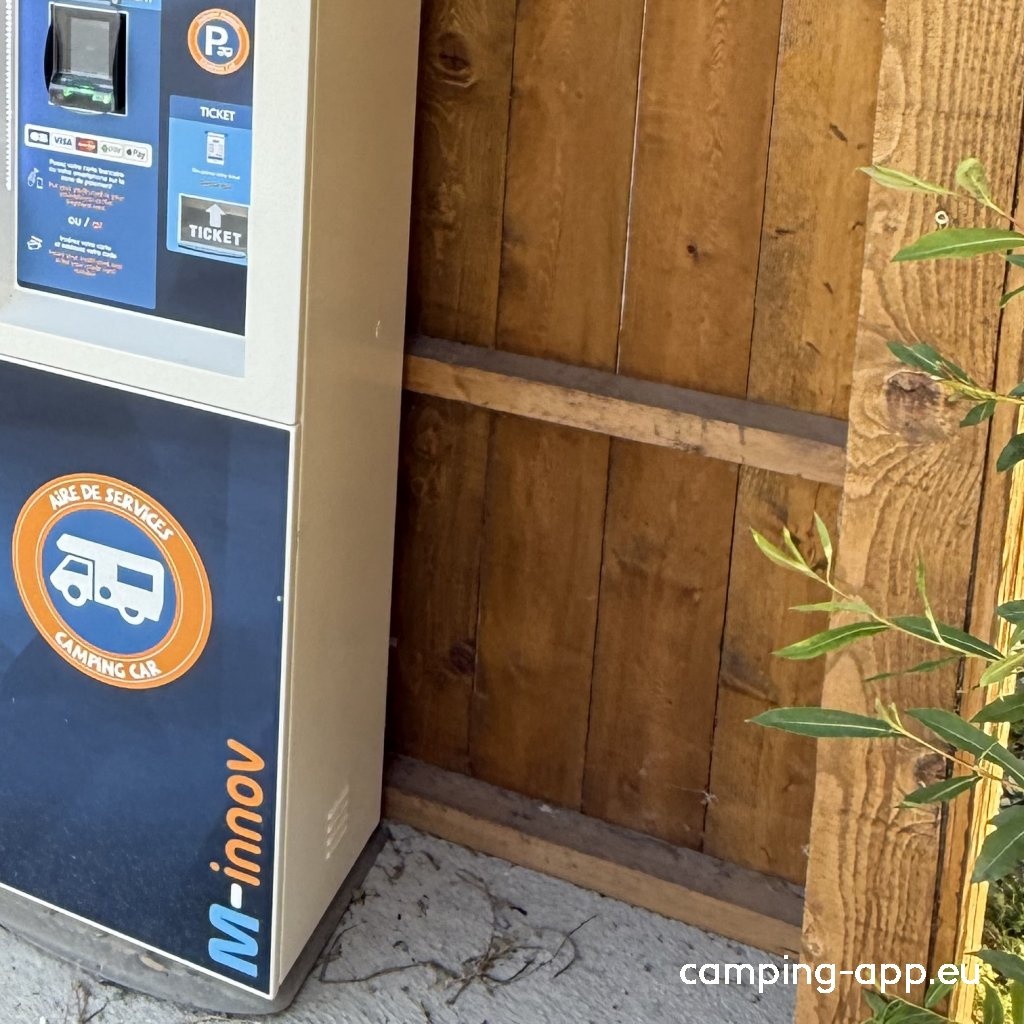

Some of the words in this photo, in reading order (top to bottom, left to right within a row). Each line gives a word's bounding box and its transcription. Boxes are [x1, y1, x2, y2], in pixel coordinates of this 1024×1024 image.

[200, 106, 235, 122] TICKET
[54, 136, 72, 146] VISA
[189, 224, 242, 246] TICKET
[80, 484, 102, 501] DE
[104, 487, 174, 541] SERVICES
[55, 631, 126, 679] CAMPING
[129, 659, 162, 679] CAR
[208, 738, 265, 978] M-innov
